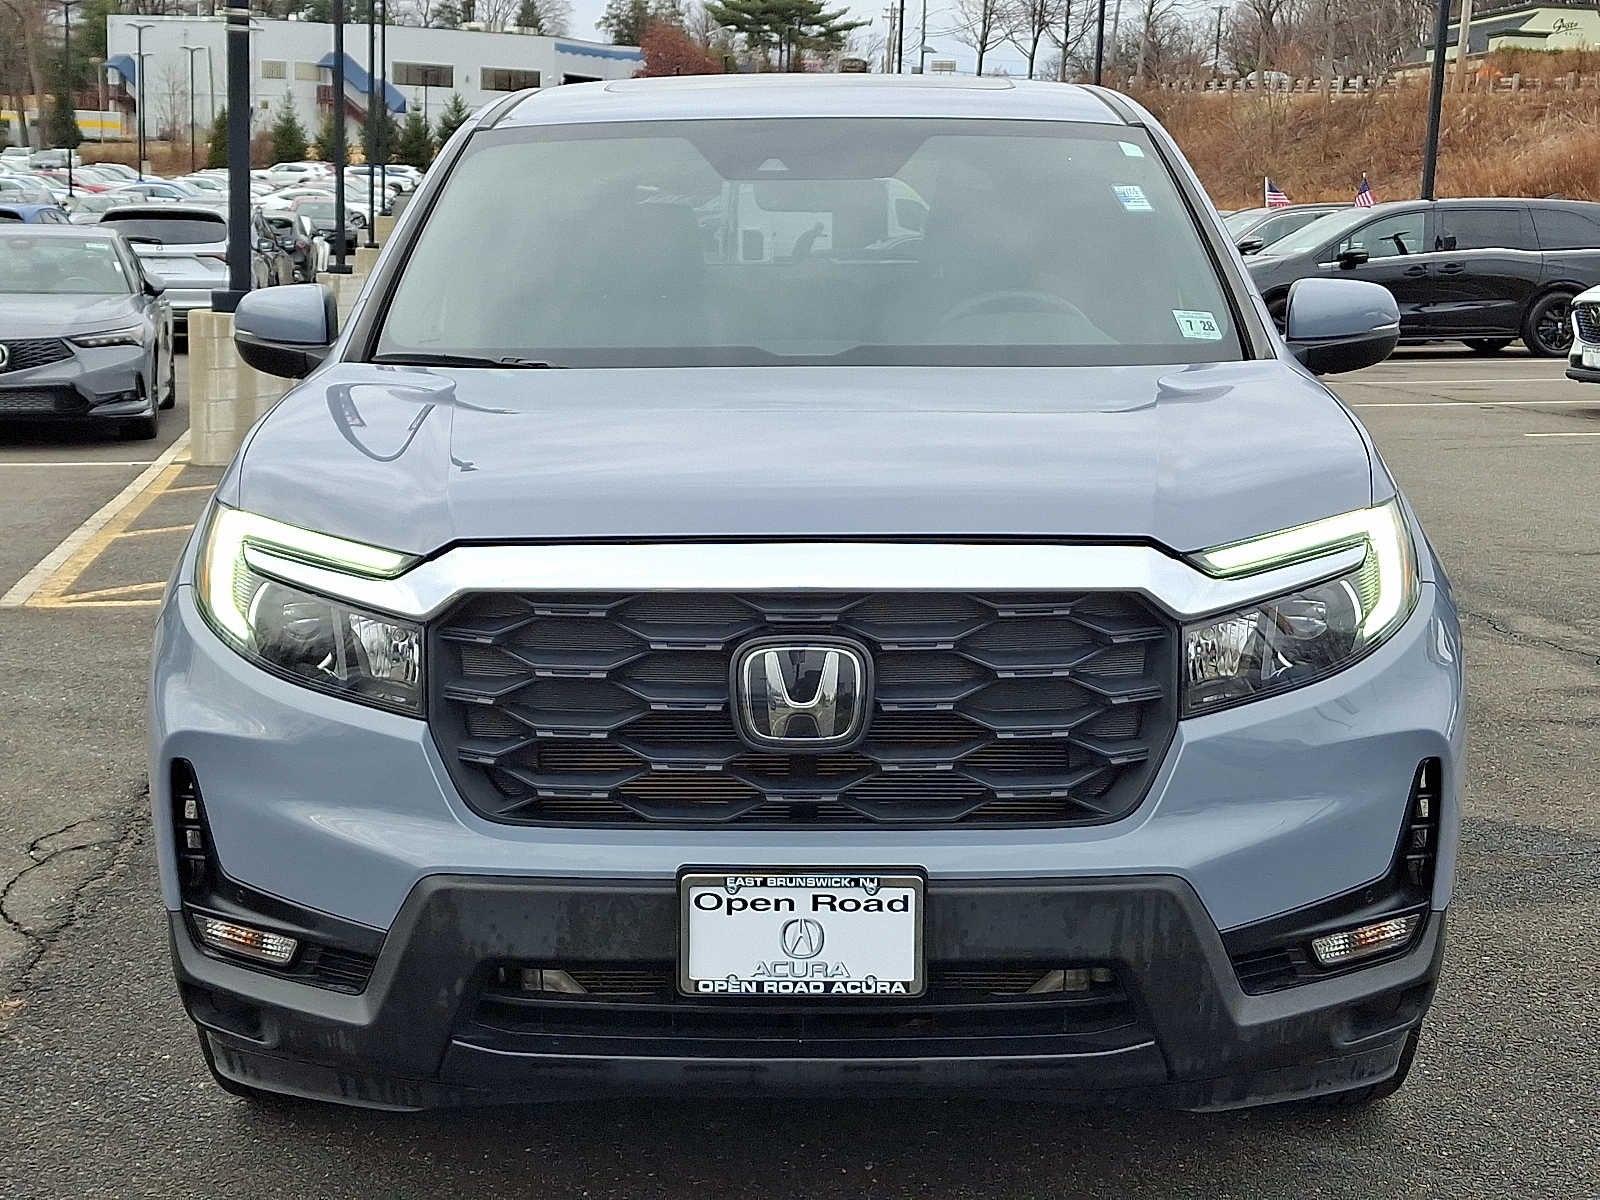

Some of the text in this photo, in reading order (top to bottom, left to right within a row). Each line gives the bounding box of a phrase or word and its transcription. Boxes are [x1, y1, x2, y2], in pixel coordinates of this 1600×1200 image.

[1185, 319, 1216, 331] 7 28
[726, 877, 878, 888] EAST BRUNSWICK, NJ
[694, 892, 909, 916] Open Road
[750, 960, 850, 978] ACURA
[698, 981, 906, 994] OPEN ROAD ACURA
